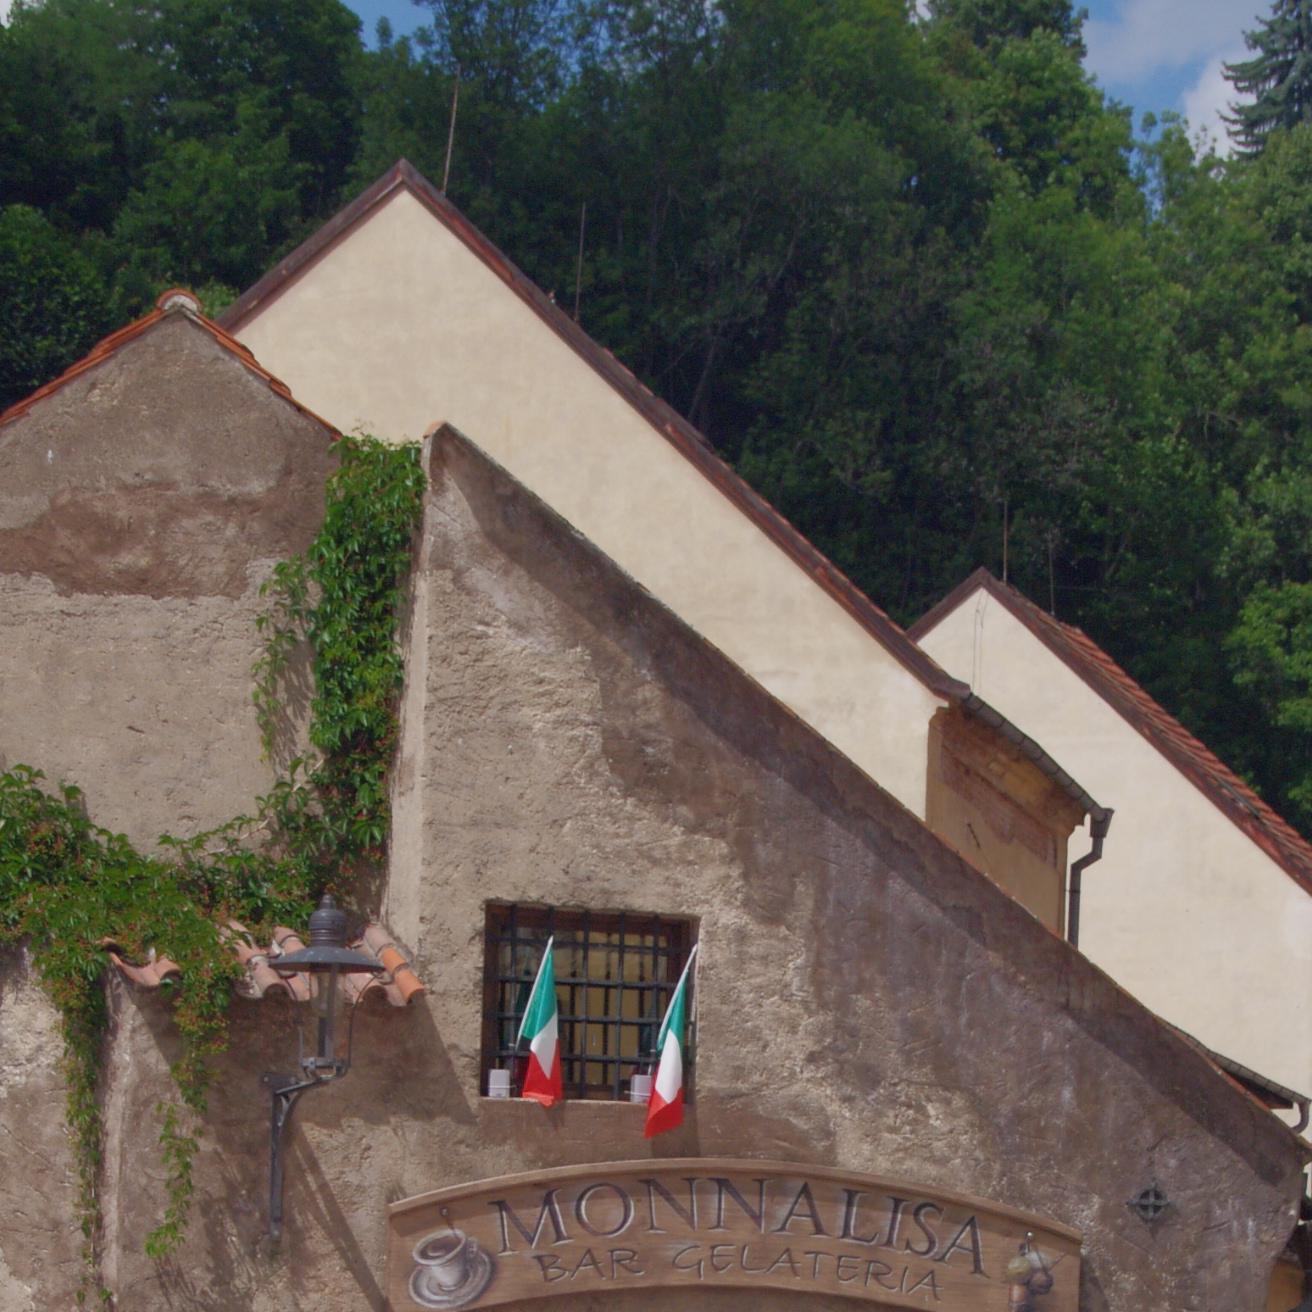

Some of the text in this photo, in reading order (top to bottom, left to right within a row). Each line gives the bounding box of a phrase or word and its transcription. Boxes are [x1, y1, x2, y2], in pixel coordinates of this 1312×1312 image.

[488, 1177, 990, 1278] MONNALISA
[532, 1243, 944, 1300] BAR GELATERIA
